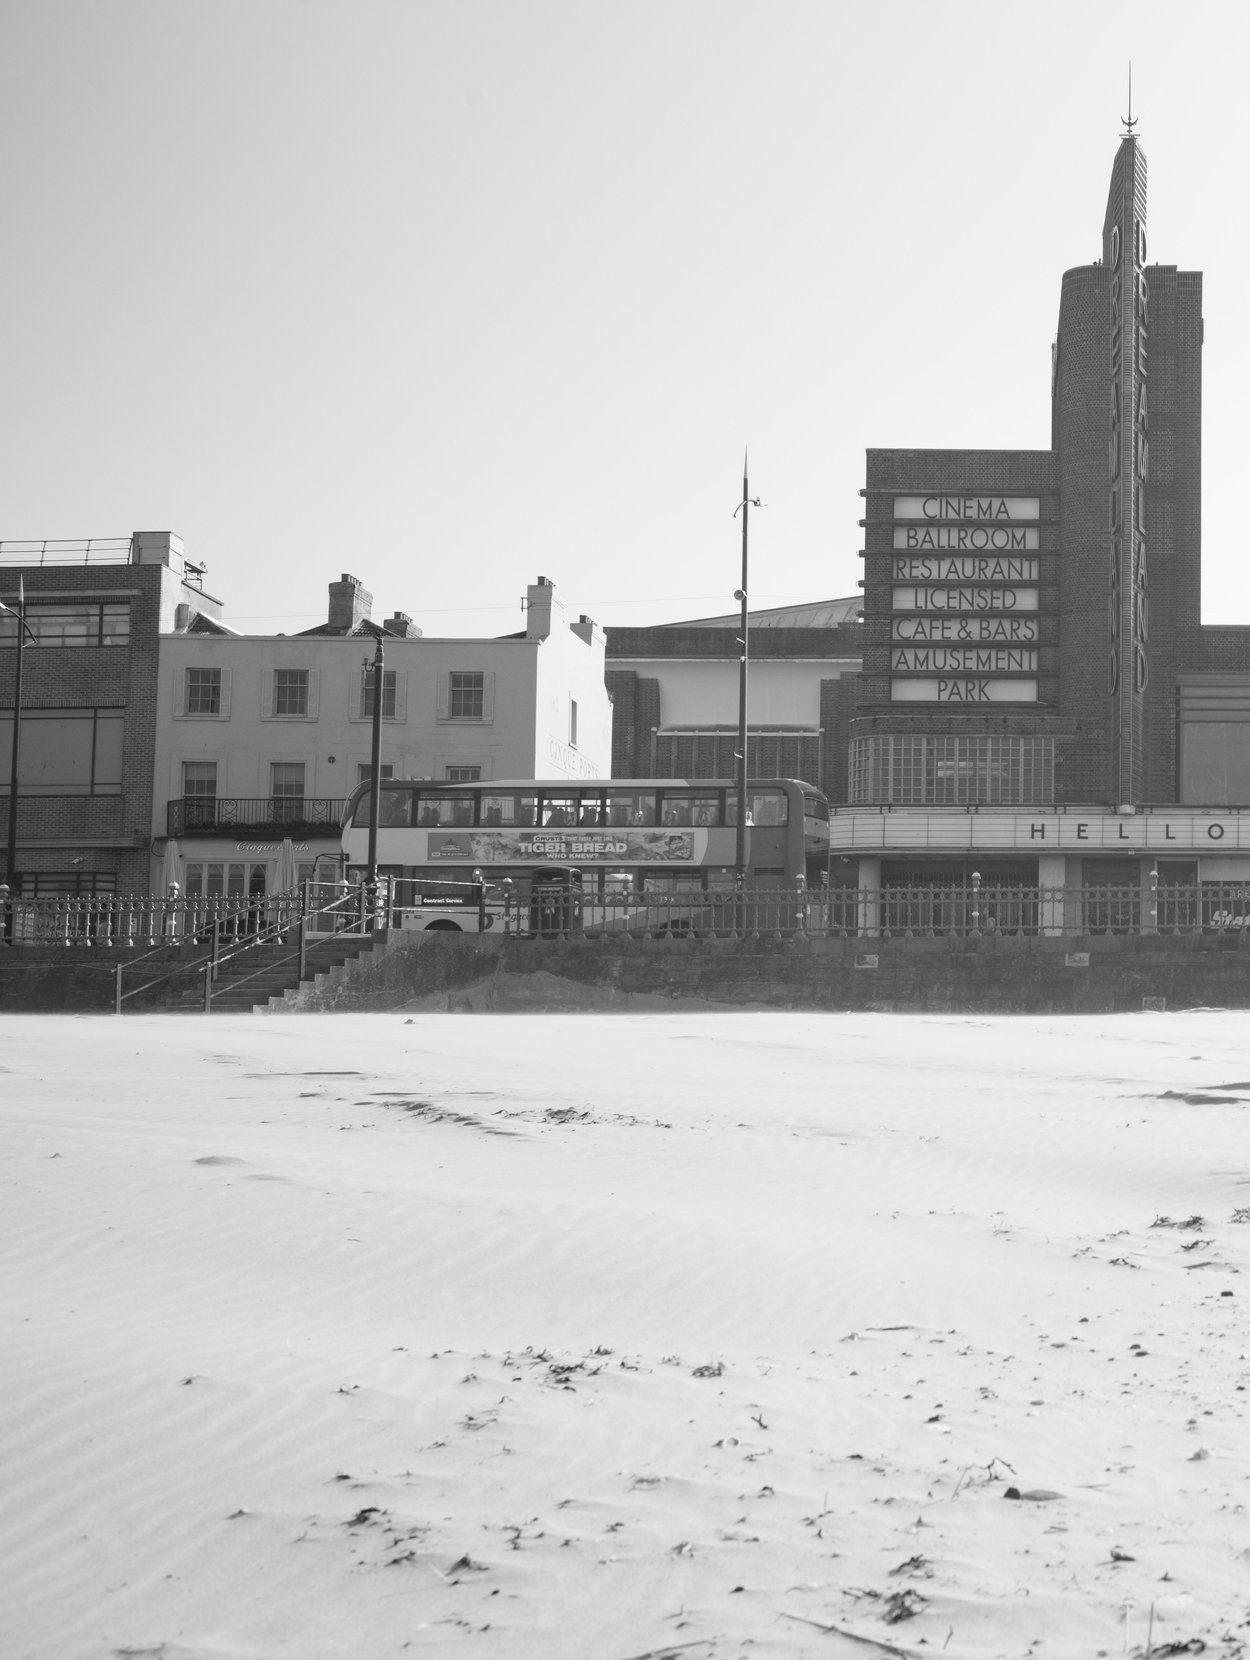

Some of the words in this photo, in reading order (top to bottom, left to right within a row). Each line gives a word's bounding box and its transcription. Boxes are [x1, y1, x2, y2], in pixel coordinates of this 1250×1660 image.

[1135, 220, 1149, 693] DREAMLAND
[922, 497, 1011, 519] CINEMA
[906, 527, 1027, 549] BALLROOM
[896, 558, 1036, 579] RESTAURANT
[914, 588, 1017, 610] LICENSED
[896, 618, 952, 640] CAFE
[957, 618, 973, 640] &
[979, 618, 1035, 641] BARS
[895, 649, 1036, 670] AMUSEMENT
[937, 679, 991, 701] PARK
[1030, 823, 1225, 840] HELLO
[518, 843, 566, 853] TIGER
[571, 843, 628, 853] BREAD
